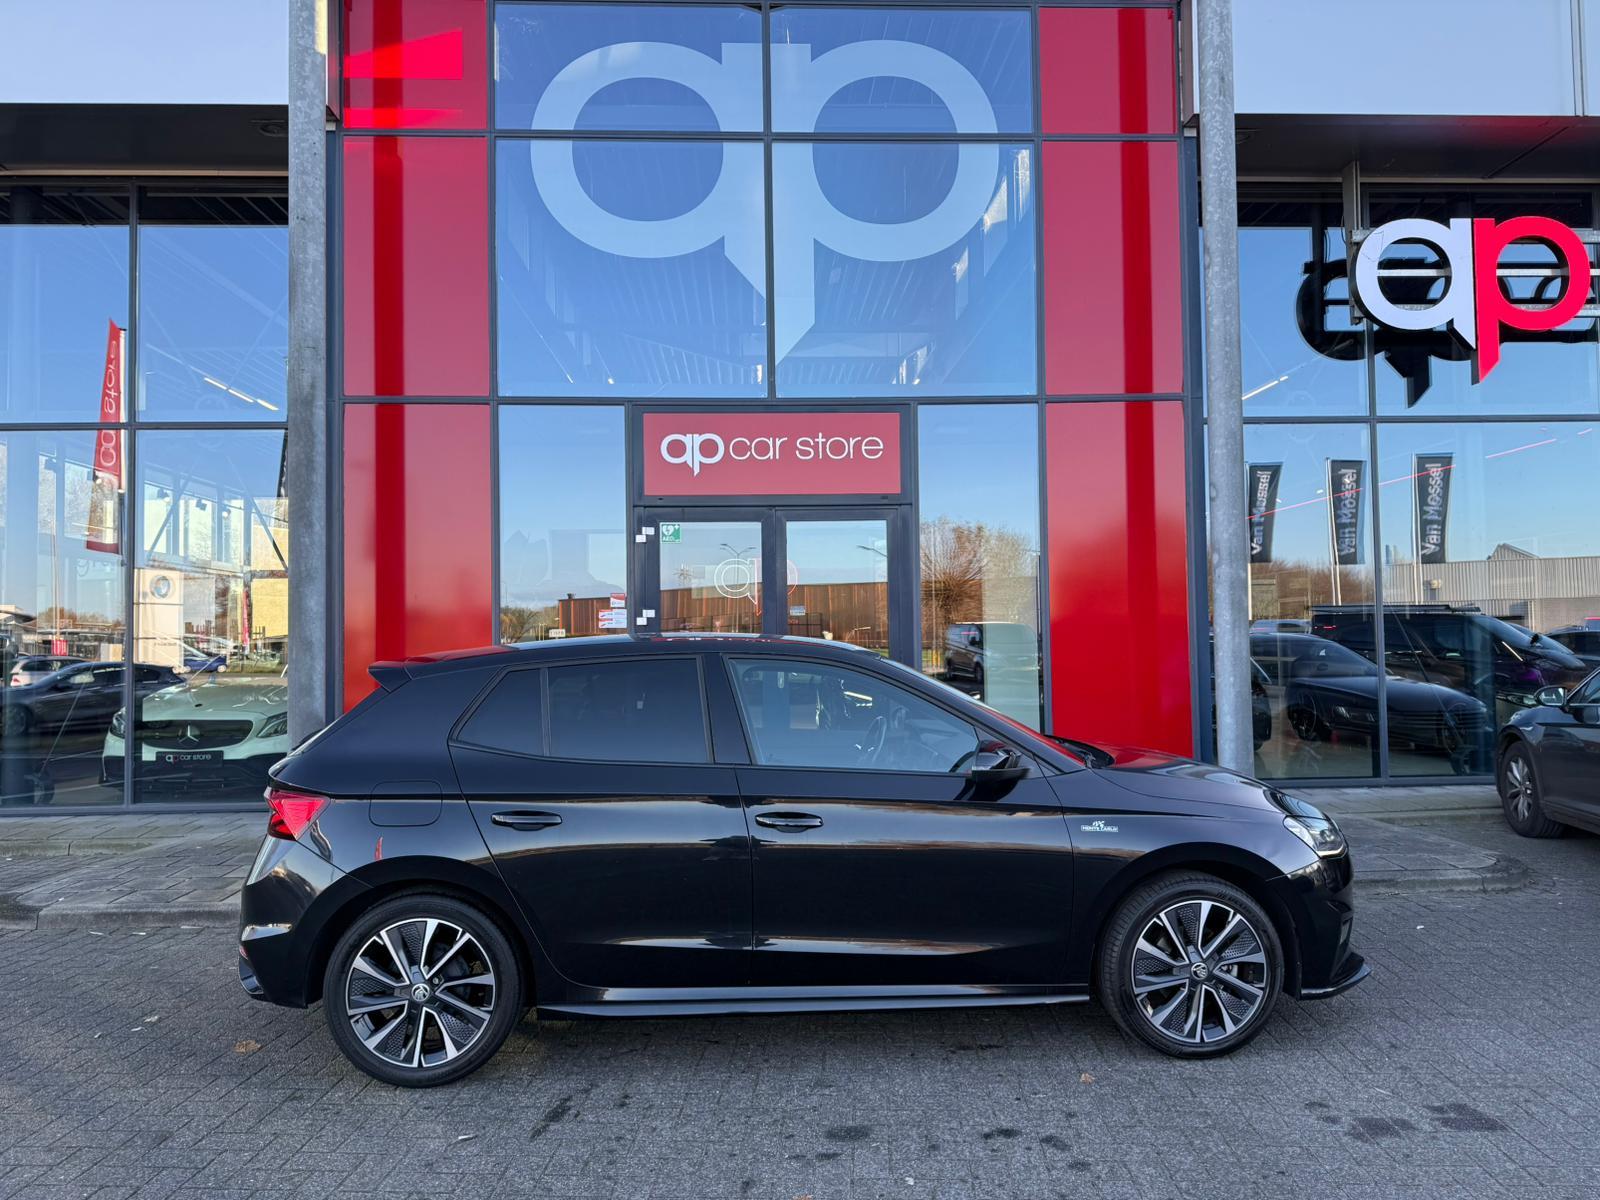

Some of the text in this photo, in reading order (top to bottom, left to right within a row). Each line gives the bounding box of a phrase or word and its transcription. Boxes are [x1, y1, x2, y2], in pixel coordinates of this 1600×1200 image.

[1355, 216, 1592, 384] ap
[660, 432, 884, 477] ap car store
[1250, 526, 1264, 555] Van
[1338, 468, 1357, 555] Van Mossel
[1421, 463, 1442, 555] Van Mossel
